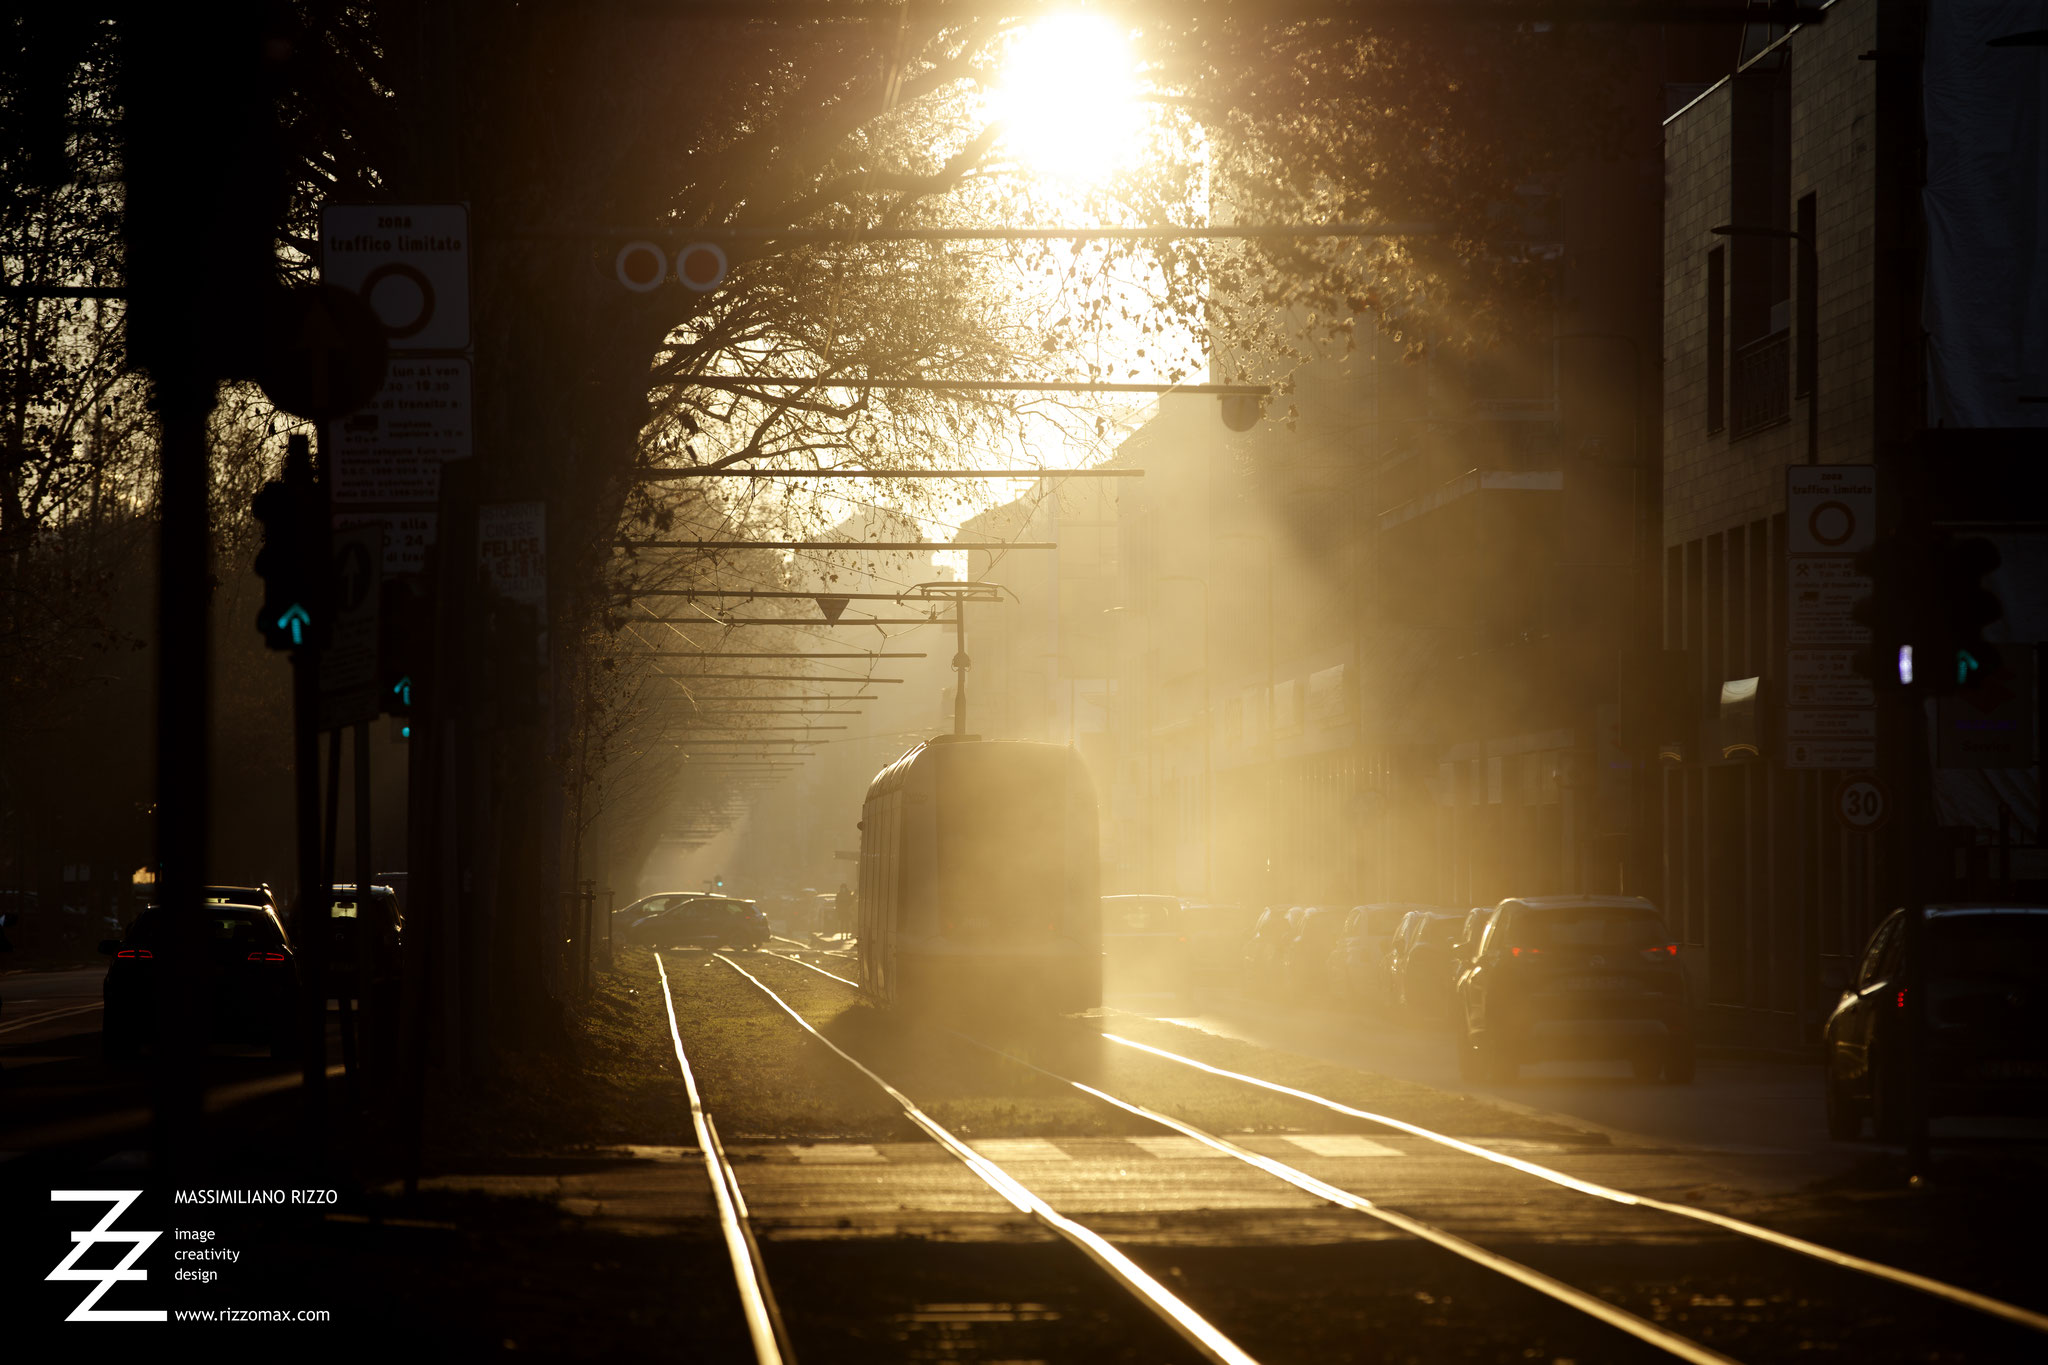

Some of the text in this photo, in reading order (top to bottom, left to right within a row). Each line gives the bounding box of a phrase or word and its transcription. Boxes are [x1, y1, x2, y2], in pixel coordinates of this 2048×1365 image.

[378, 216, 411, 229] zona
[331, 235, 461, 252] traffico limitato
[1792, 484, 1873, 495] traffico limitato
[405, 535, 423, 547] 24
[482, 537, 539, 558] FELICE
[1847, 790, 1878, 817] 30
